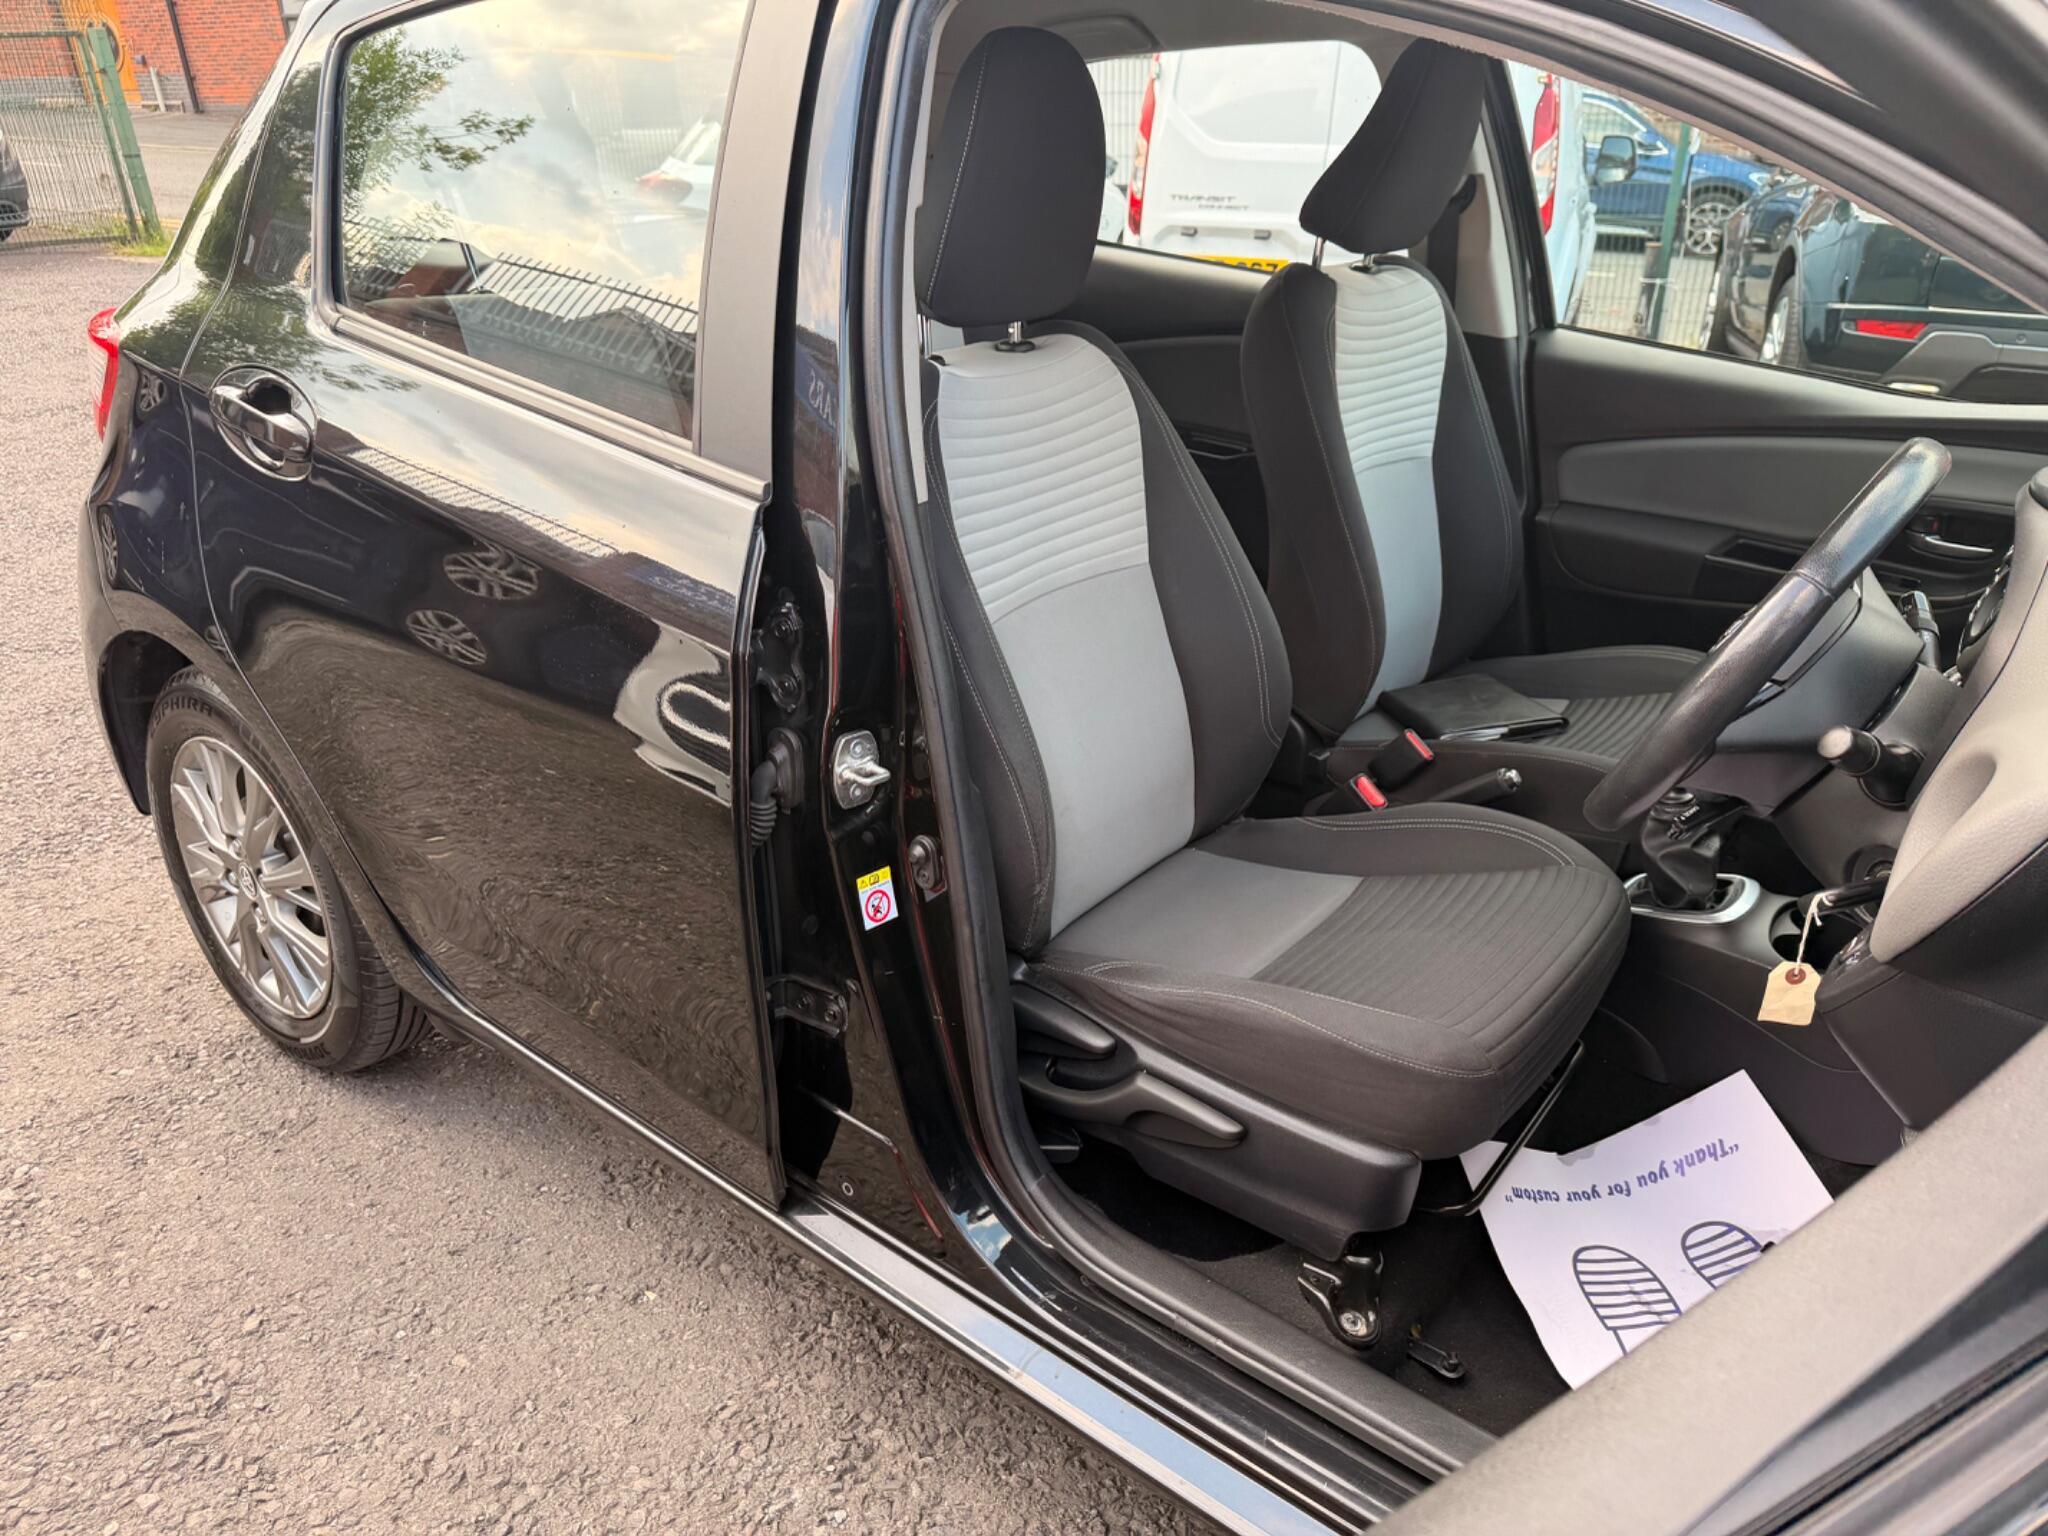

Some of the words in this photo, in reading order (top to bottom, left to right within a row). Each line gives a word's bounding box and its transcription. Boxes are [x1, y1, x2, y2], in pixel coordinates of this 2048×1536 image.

[1636, 1160, 1669, 1188] you
[1566, 1184, 1601, 1202] your
[1607, 1181, 1632, 1197] for
